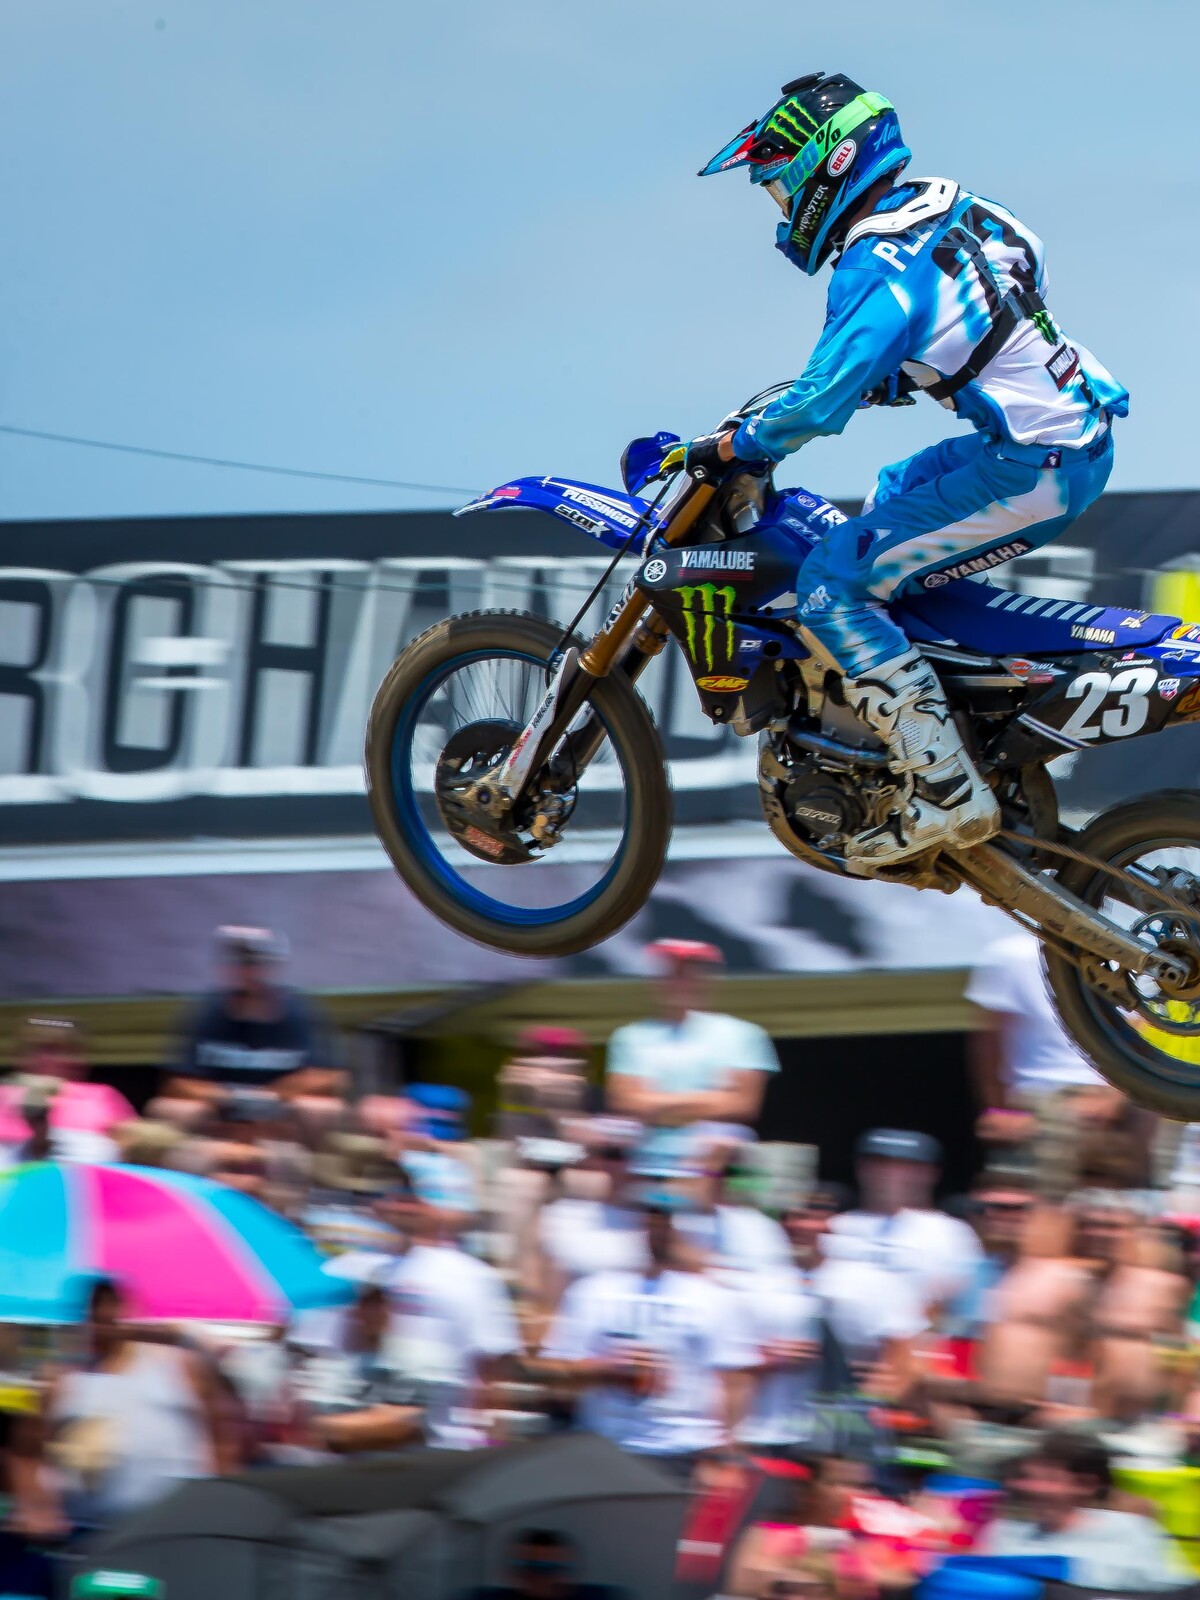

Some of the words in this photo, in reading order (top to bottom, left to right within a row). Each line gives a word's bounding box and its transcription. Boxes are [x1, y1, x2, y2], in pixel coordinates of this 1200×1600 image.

[780, 127, 842, 198] 100%
[830, 143, 853, 173] BELL
[798, 184, 829, 233] MONSTER
[561, 488, 639, 530] PLESSINGER
[681, 550, 756, 571] YAMALUBE
[946, 541, 1029, 580] YAMAHA
[1070, 624, 1115, 645] YAMAHA
[697, 677, 750, 689] FMF
[1060, 667, 1159, 740] 23
